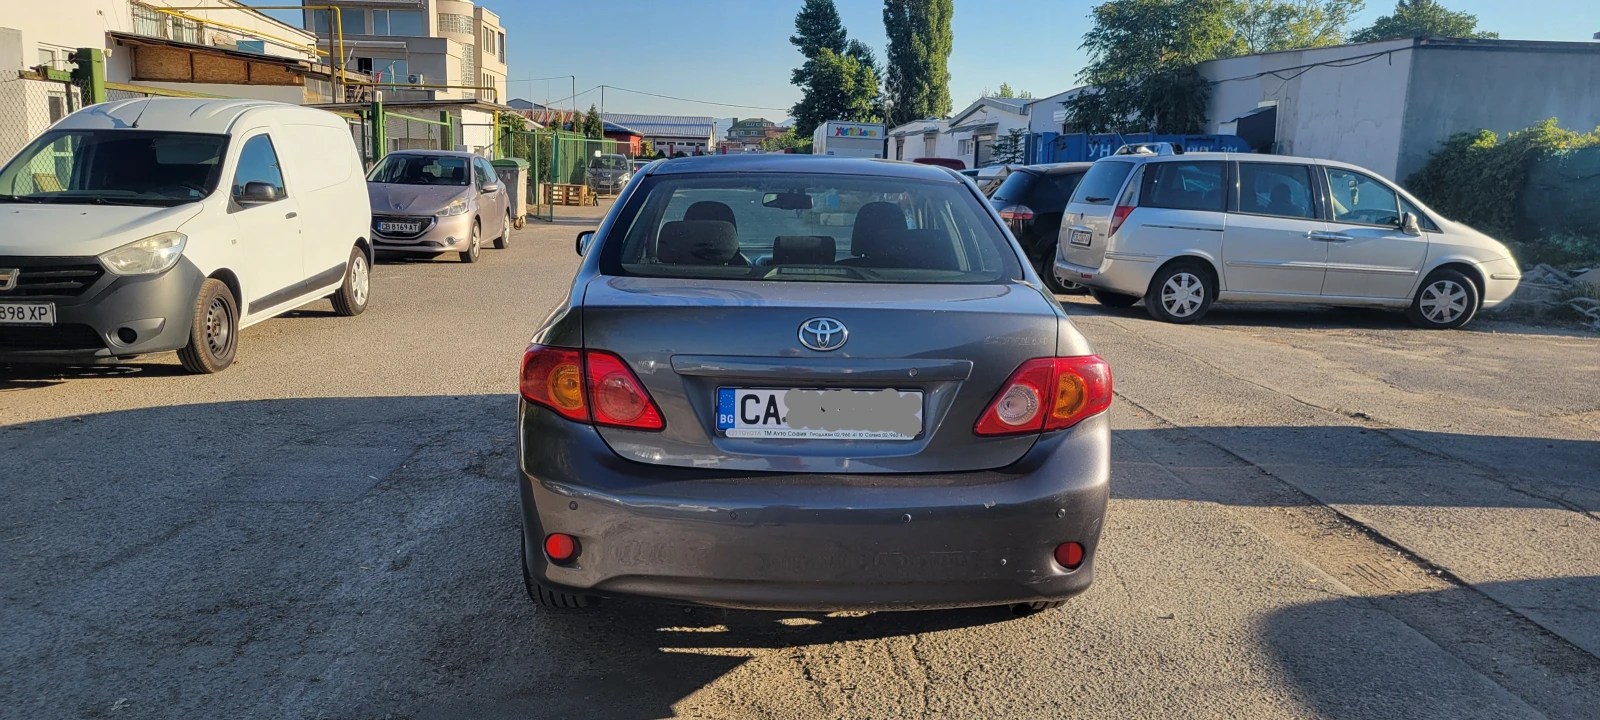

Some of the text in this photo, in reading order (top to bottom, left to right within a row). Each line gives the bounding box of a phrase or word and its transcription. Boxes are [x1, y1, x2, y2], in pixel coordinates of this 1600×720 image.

[391, 223, 408, 231] 8169
[28, 306, 48, 321] XP
[720, 414, 734, 424] BG
